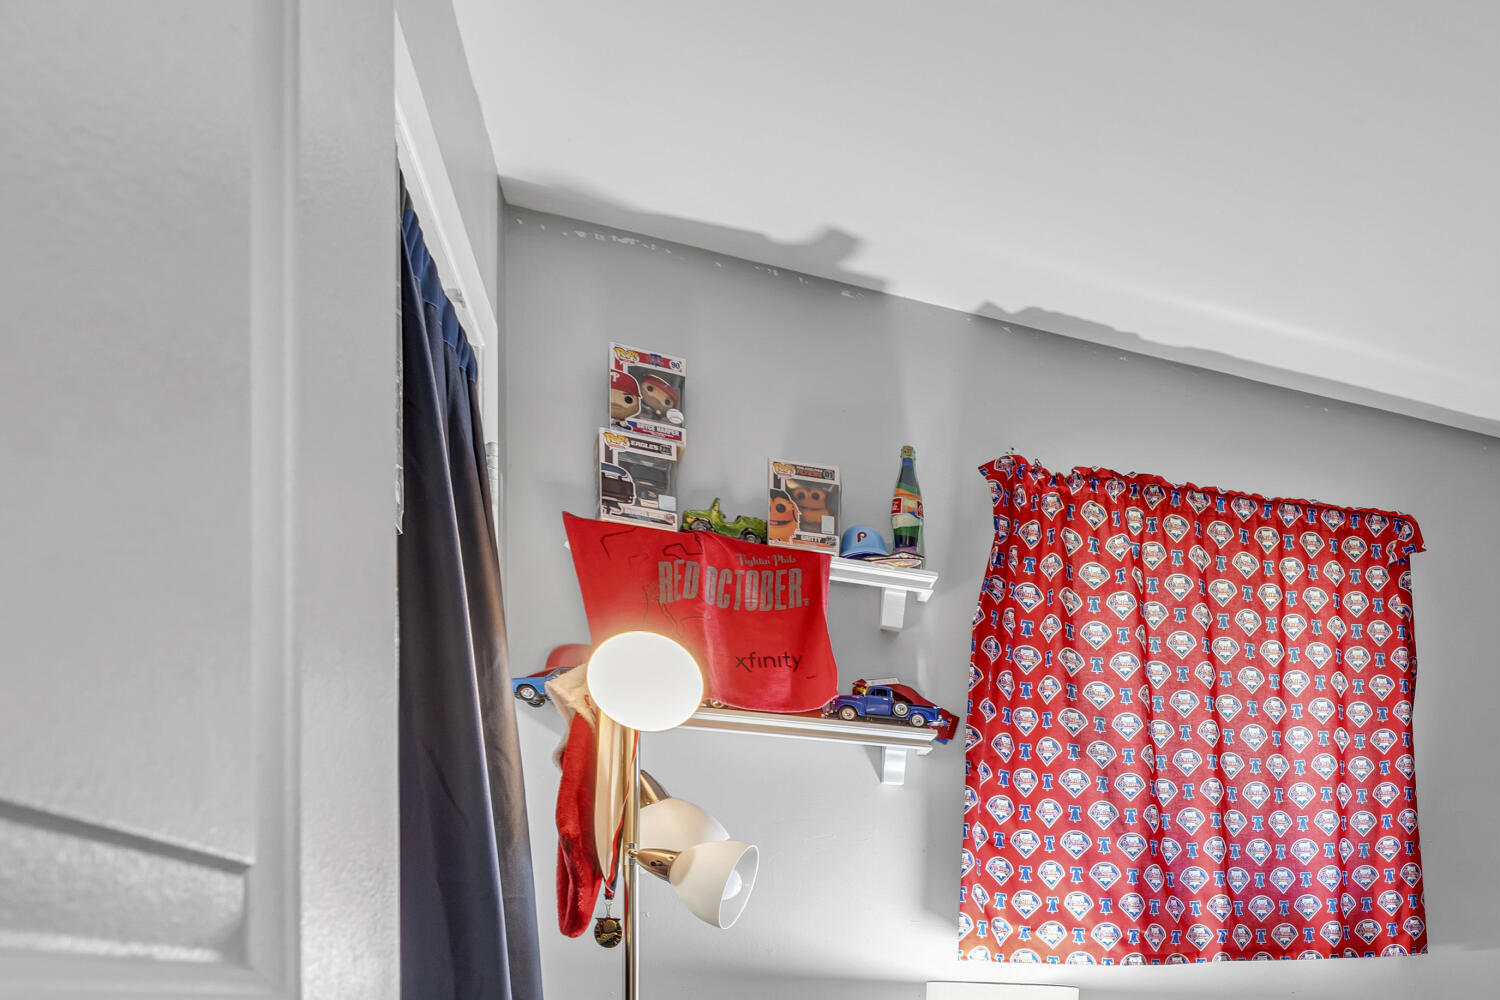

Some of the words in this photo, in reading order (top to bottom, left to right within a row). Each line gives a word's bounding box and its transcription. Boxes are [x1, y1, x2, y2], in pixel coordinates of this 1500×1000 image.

[630, 440, 660, 451] EAGLES
[658, 559, 700, 604] RED
[735, 652, 803, 673] xfinity
